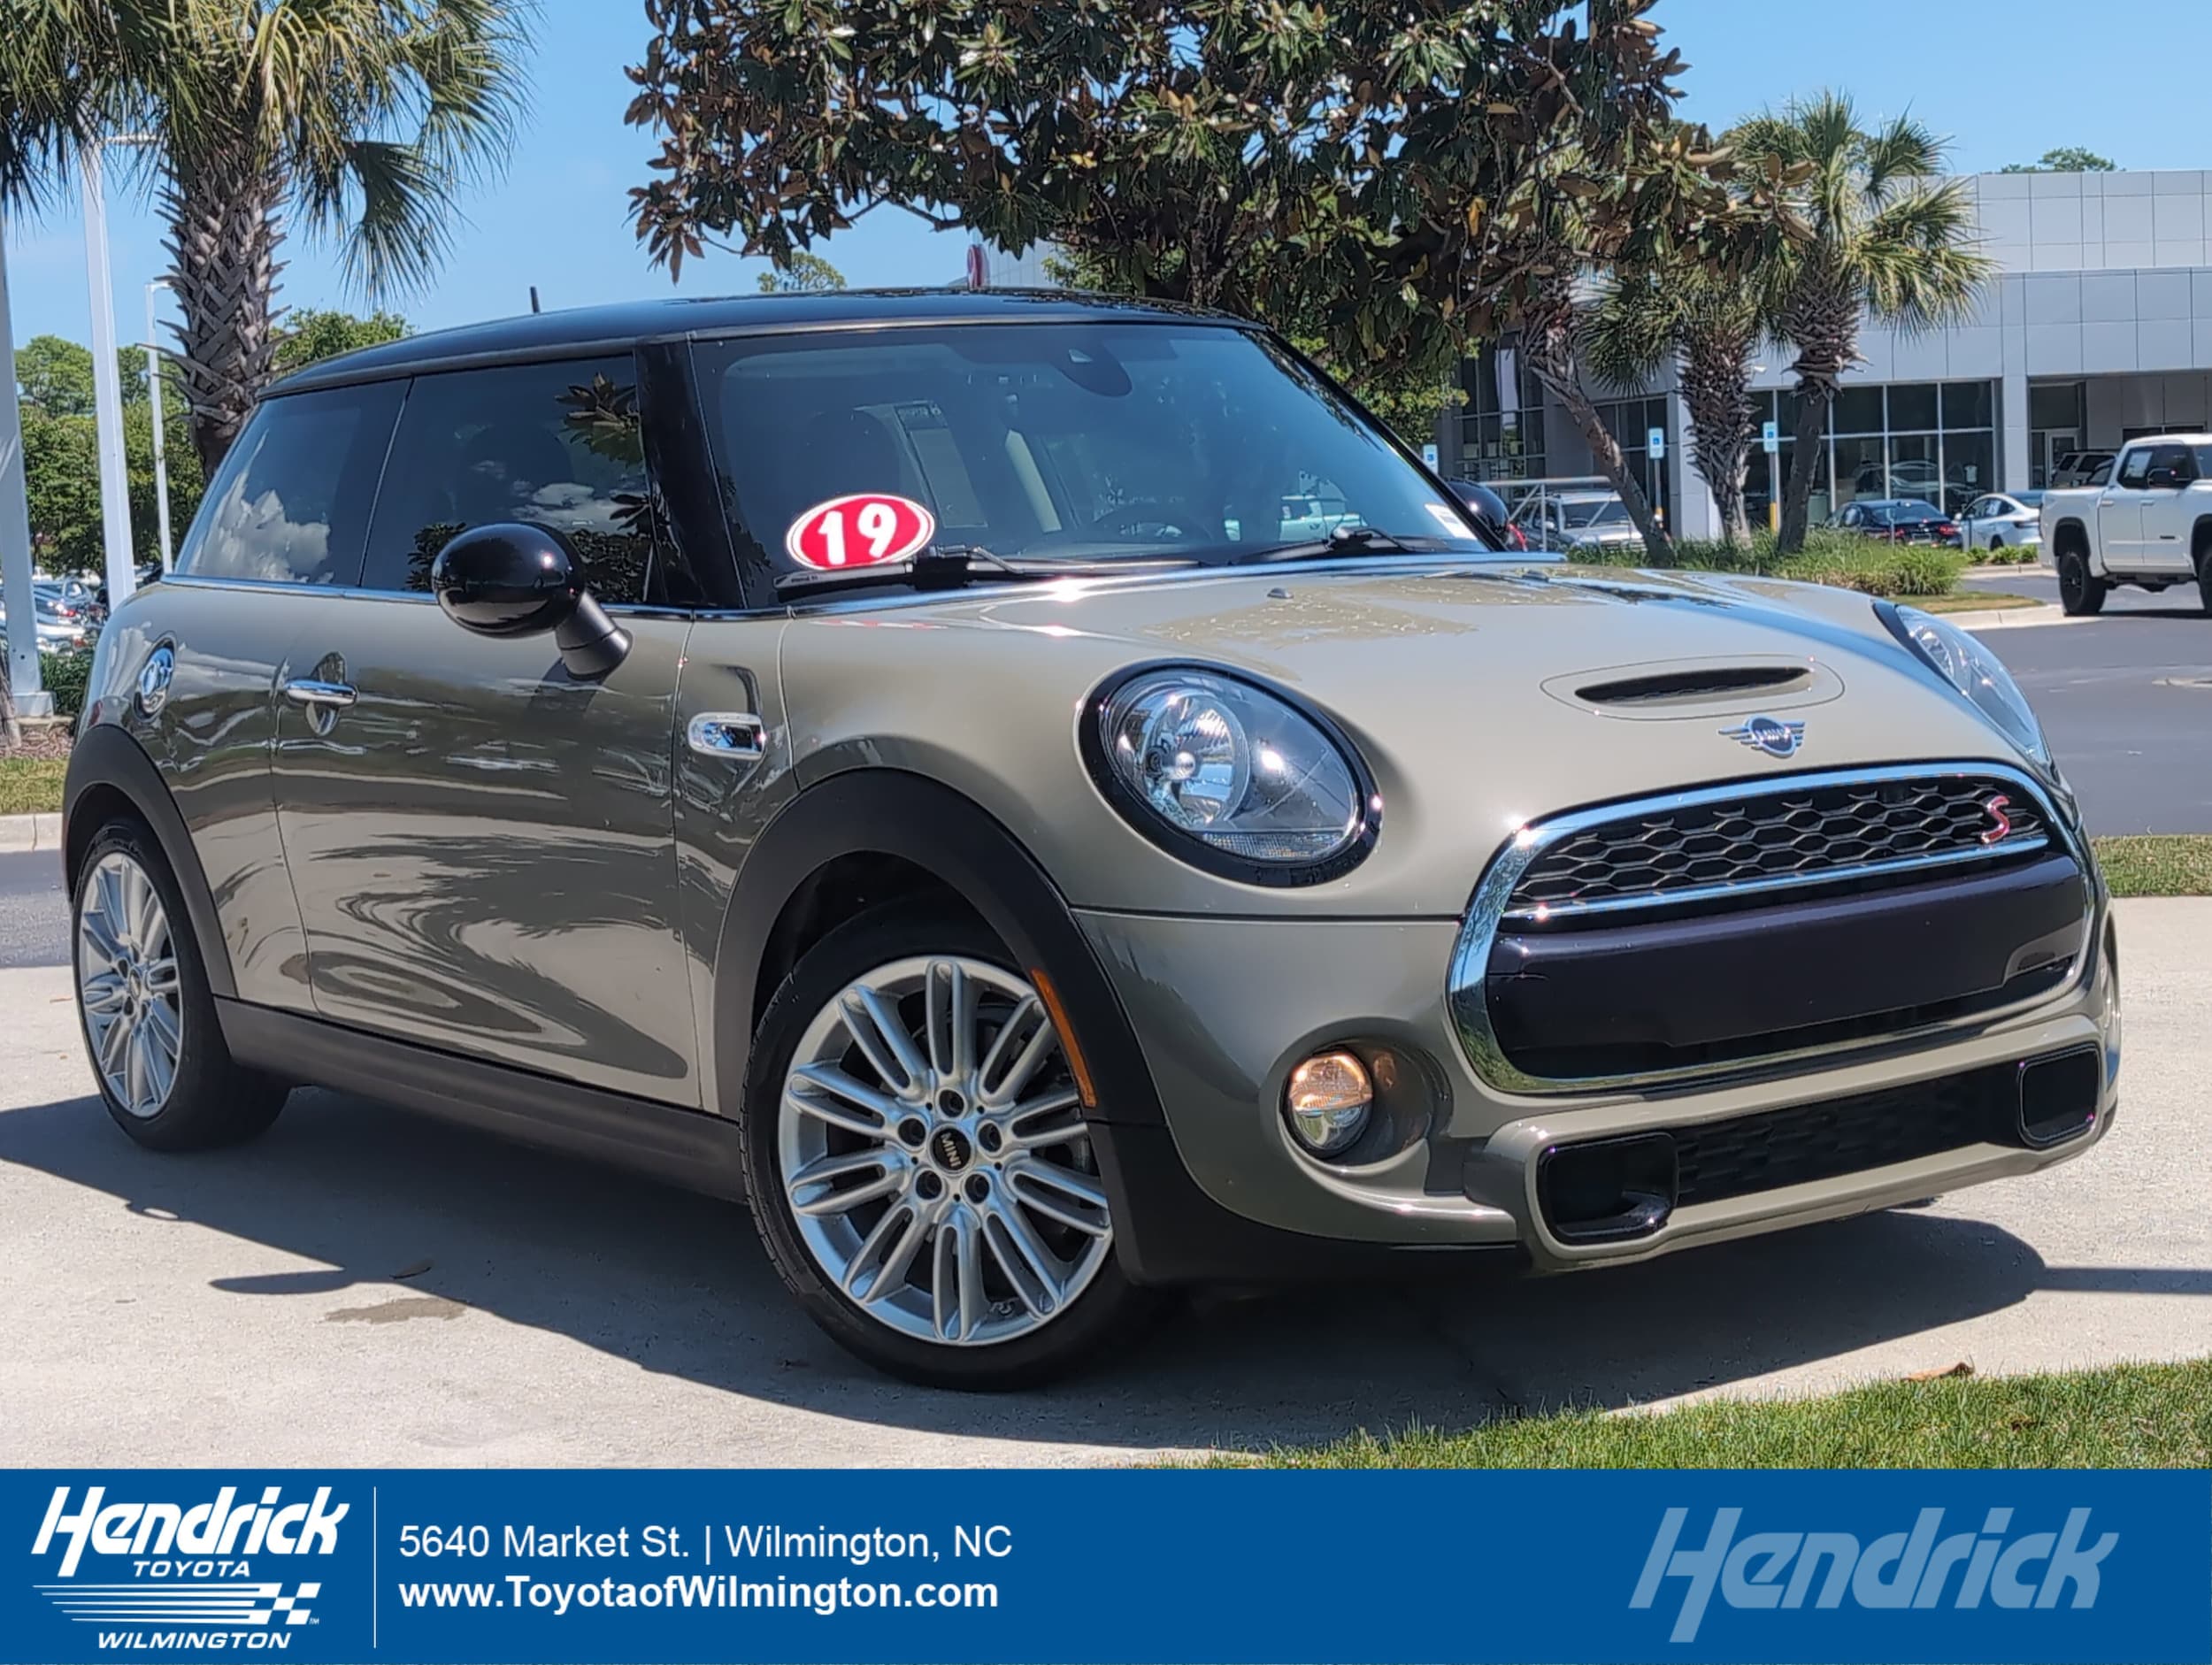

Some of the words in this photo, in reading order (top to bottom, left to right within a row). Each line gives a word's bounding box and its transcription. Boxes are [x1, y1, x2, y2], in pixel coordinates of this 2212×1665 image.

[817, 503, 898, 566] 19
[1980, 794, 2010, 844] S
[941, 1132, 962, 1168] MINI
